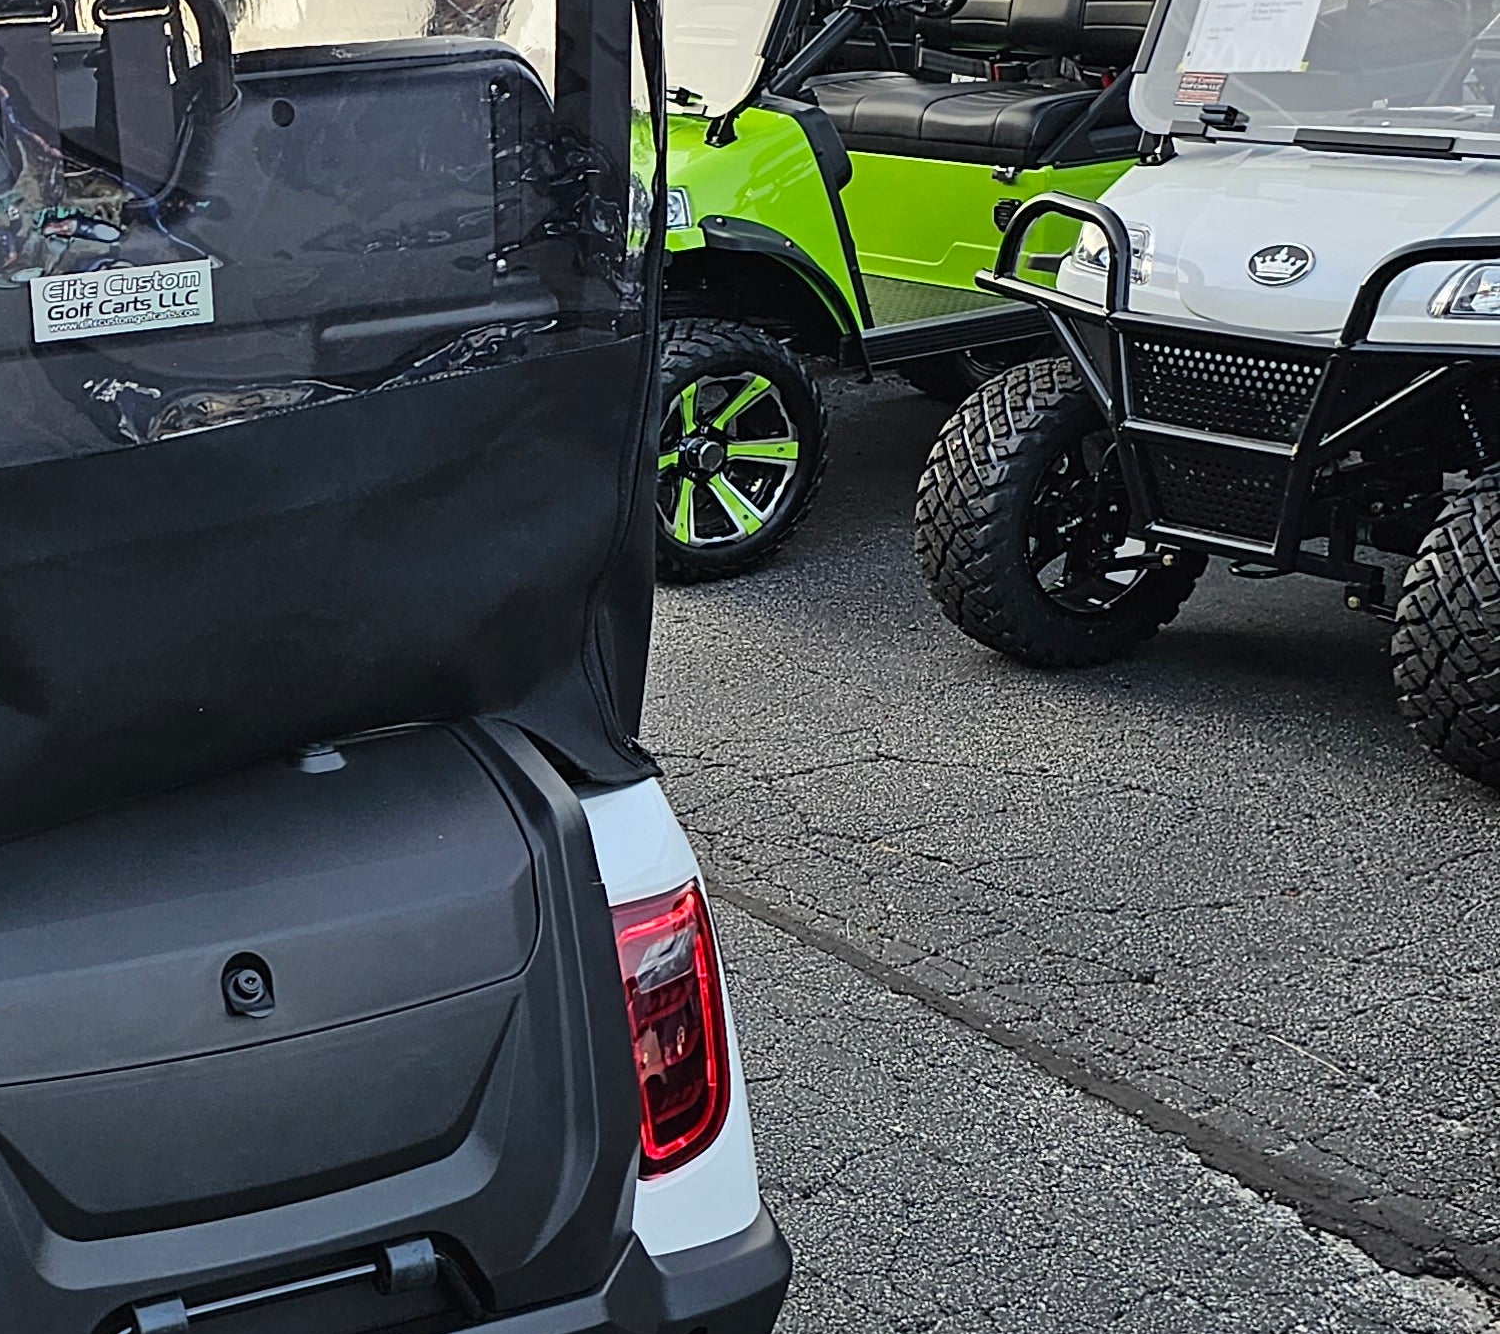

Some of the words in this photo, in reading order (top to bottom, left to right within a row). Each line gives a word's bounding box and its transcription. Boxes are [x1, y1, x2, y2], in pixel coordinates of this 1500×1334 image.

[43, 279, 98, 303] Elite
[104, 270, 201, 296] Custom
[47, 301, 93, 321] Golf
[98, 296, 152, 315] Carts
[158, 289, 199, 308] LLC
[48, 307, 201, 333] www.elitecustomgolfcarts.com
